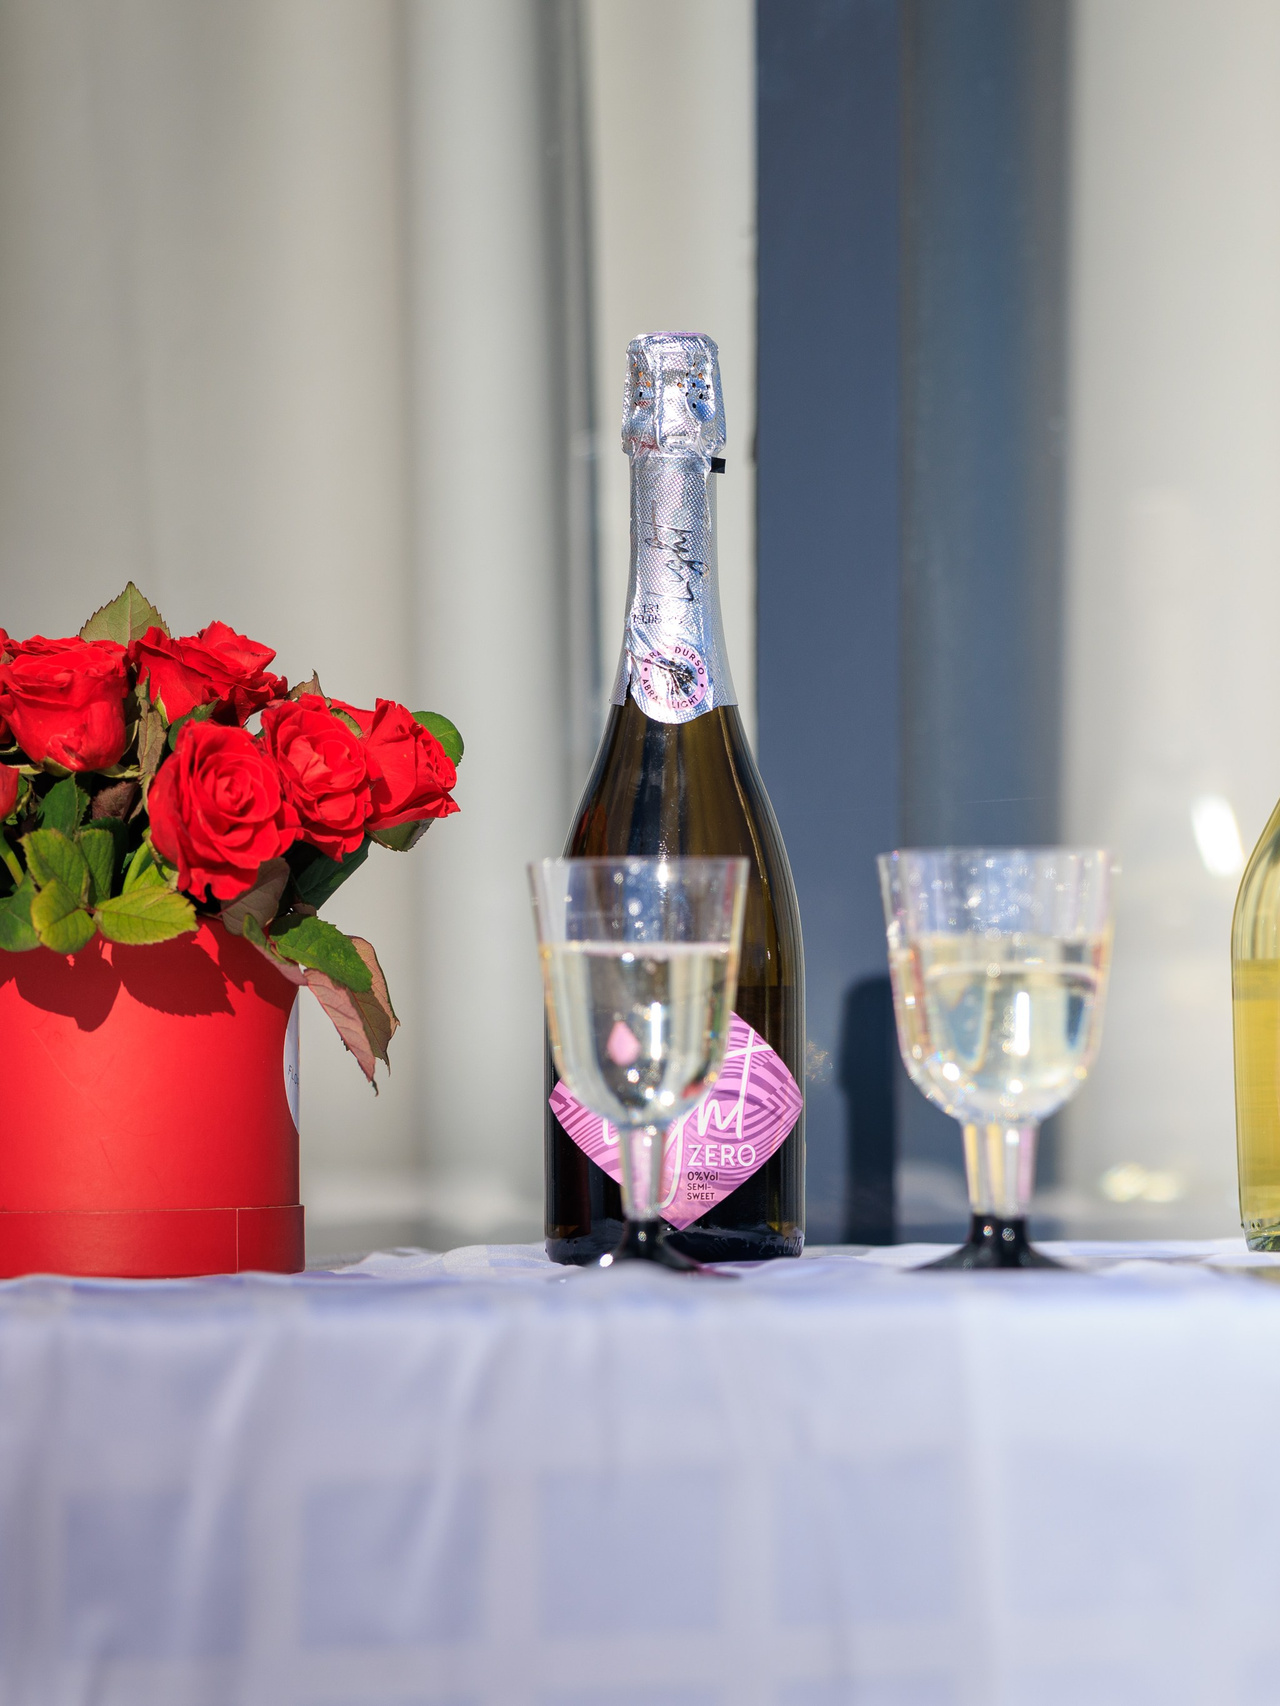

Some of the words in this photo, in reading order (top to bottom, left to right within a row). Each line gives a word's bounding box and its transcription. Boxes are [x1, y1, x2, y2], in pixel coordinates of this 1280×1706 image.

[674, 646, 705, 675] DURSO
[671, 694, 699, 709] LIGHT
[687, 1144, 757, 1167] ZERO
[687, 1171, 719, 1182] 0%Vol
[687, 1183, 712, 1191] SEMI-
[687, 1192, 716, 1201] SWEET
